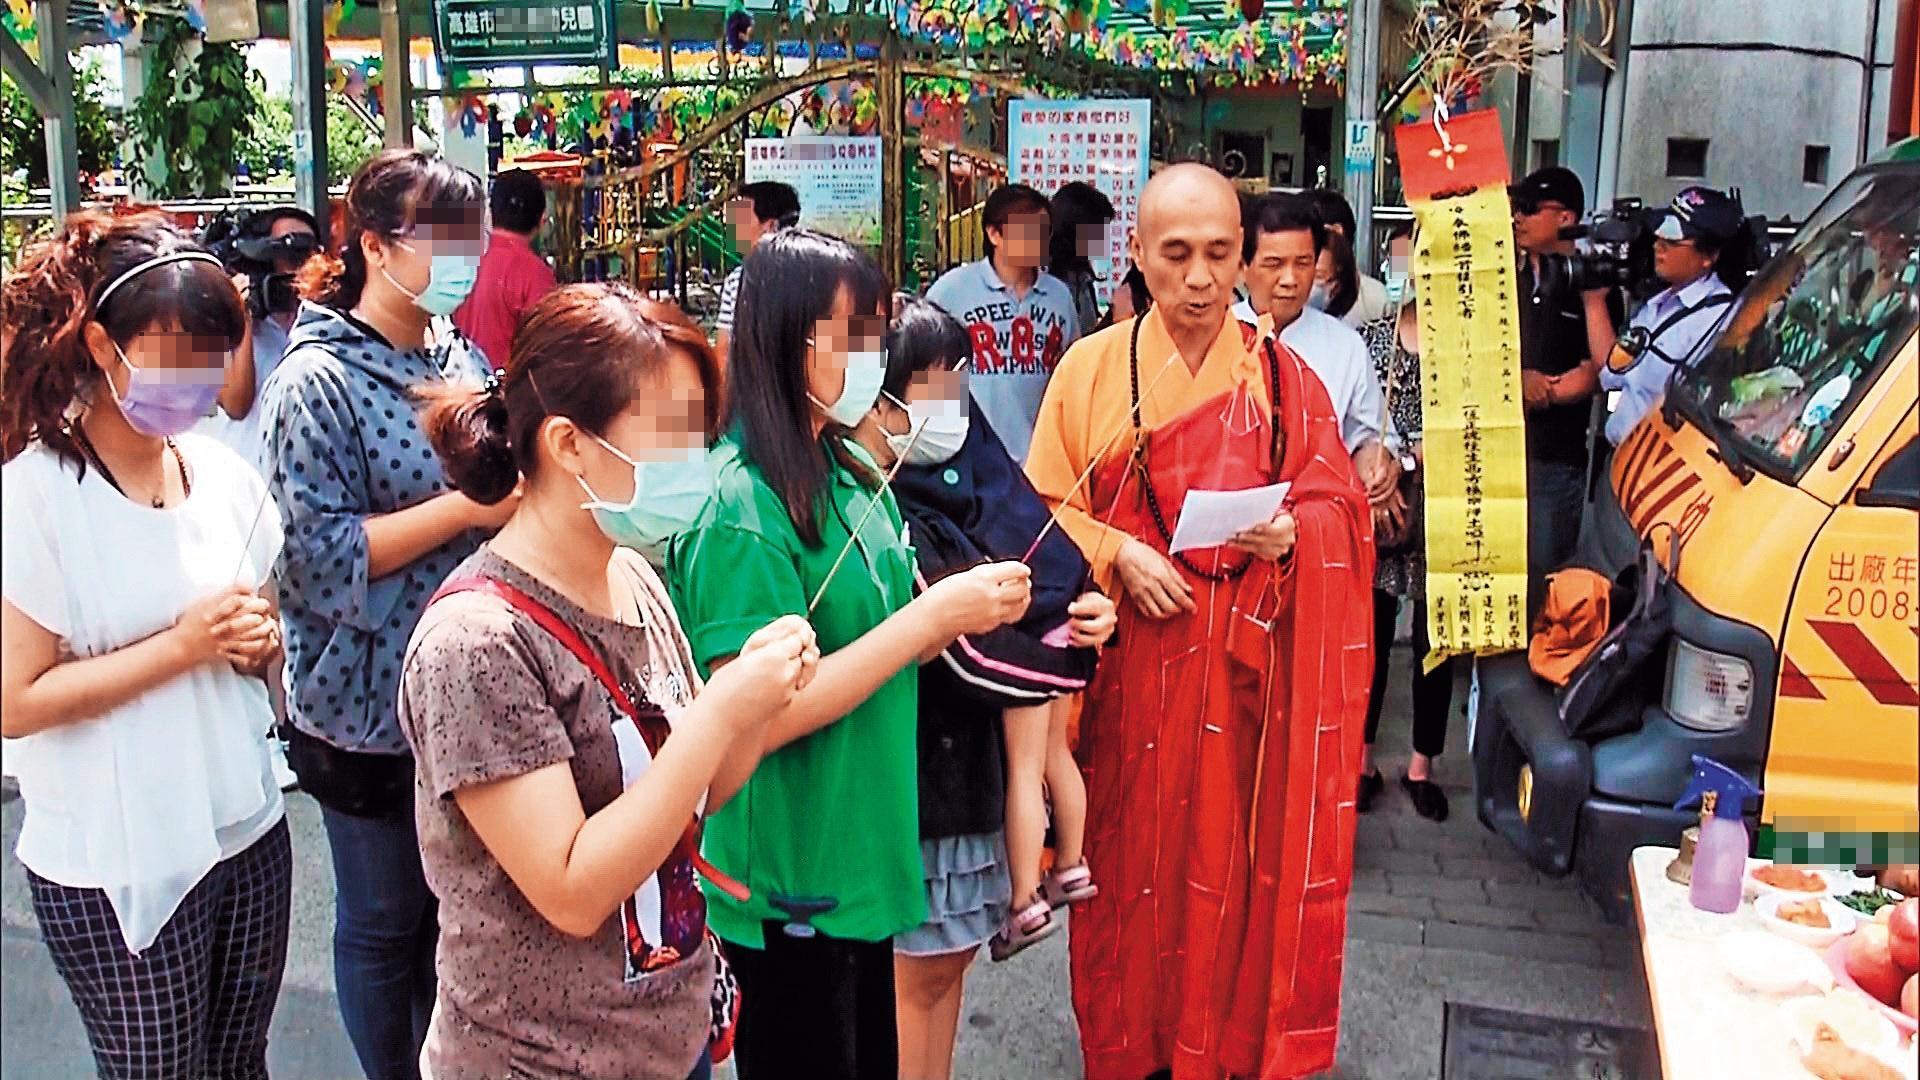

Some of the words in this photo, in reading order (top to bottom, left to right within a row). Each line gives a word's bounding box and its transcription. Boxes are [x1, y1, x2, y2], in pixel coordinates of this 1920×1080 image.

[1828, 552, 1916, 585] 出廠年
[1825, 586, 1909, 620] 2008
